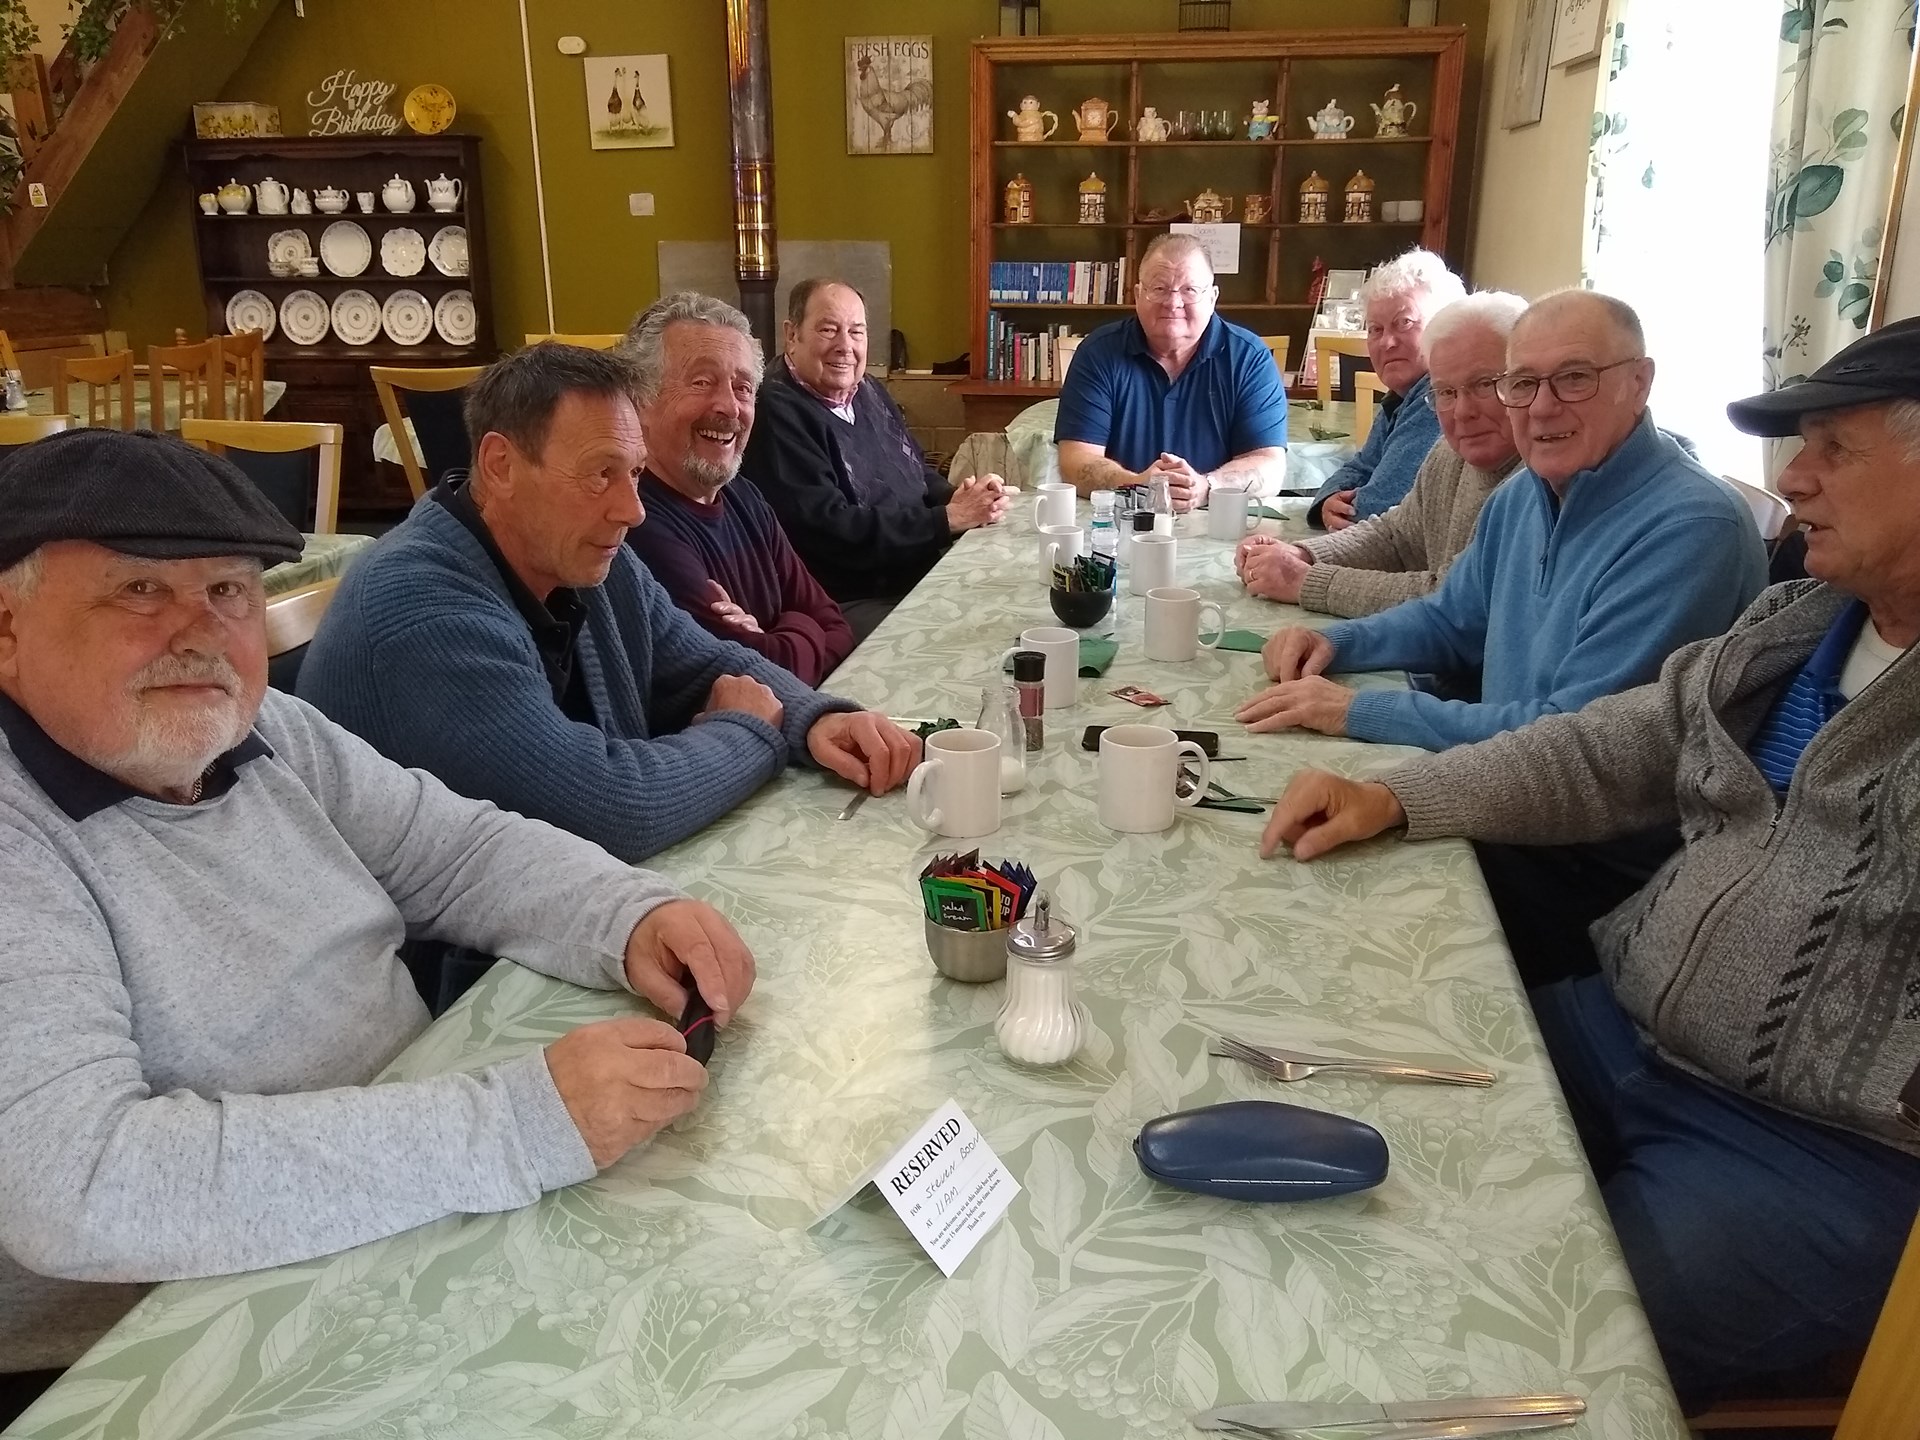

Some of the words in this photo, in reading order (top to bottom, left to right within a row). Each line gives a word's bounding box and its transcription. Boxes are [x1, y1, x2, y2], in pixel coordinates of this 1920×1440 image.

[850, 42, 889, 60] FRESH
[894, 41, 929, 59] EGGS
[307, 69, 395, 107] Happy
[309, 105, 402, 137] Birthday
[942, 901, 965, 913] salad
[890, 1118, 961, 1196] RESERVED
[910, 1203, 922, 1217] FOR
[929, 1237, 939, 1246] You
[943, 1215, 958, 1232] welcome
[968, 1193, 976, 1203] this
[974, 1184, 983, 1196] table
[981, 1178, 989, 1187] but
[988, 1168, 998, 1181] please
[925, 1218, 933, 1228] AT
[940, 1237, 951, 1250] vacate
[949, 1230, 956, 1238] 15
[954, 1217, 969, 1234] minutes
[966, 1205, 978, 1218] before
[982, 1190, 991, 1200] time
[967, 1217, 979, 1231] Thank
